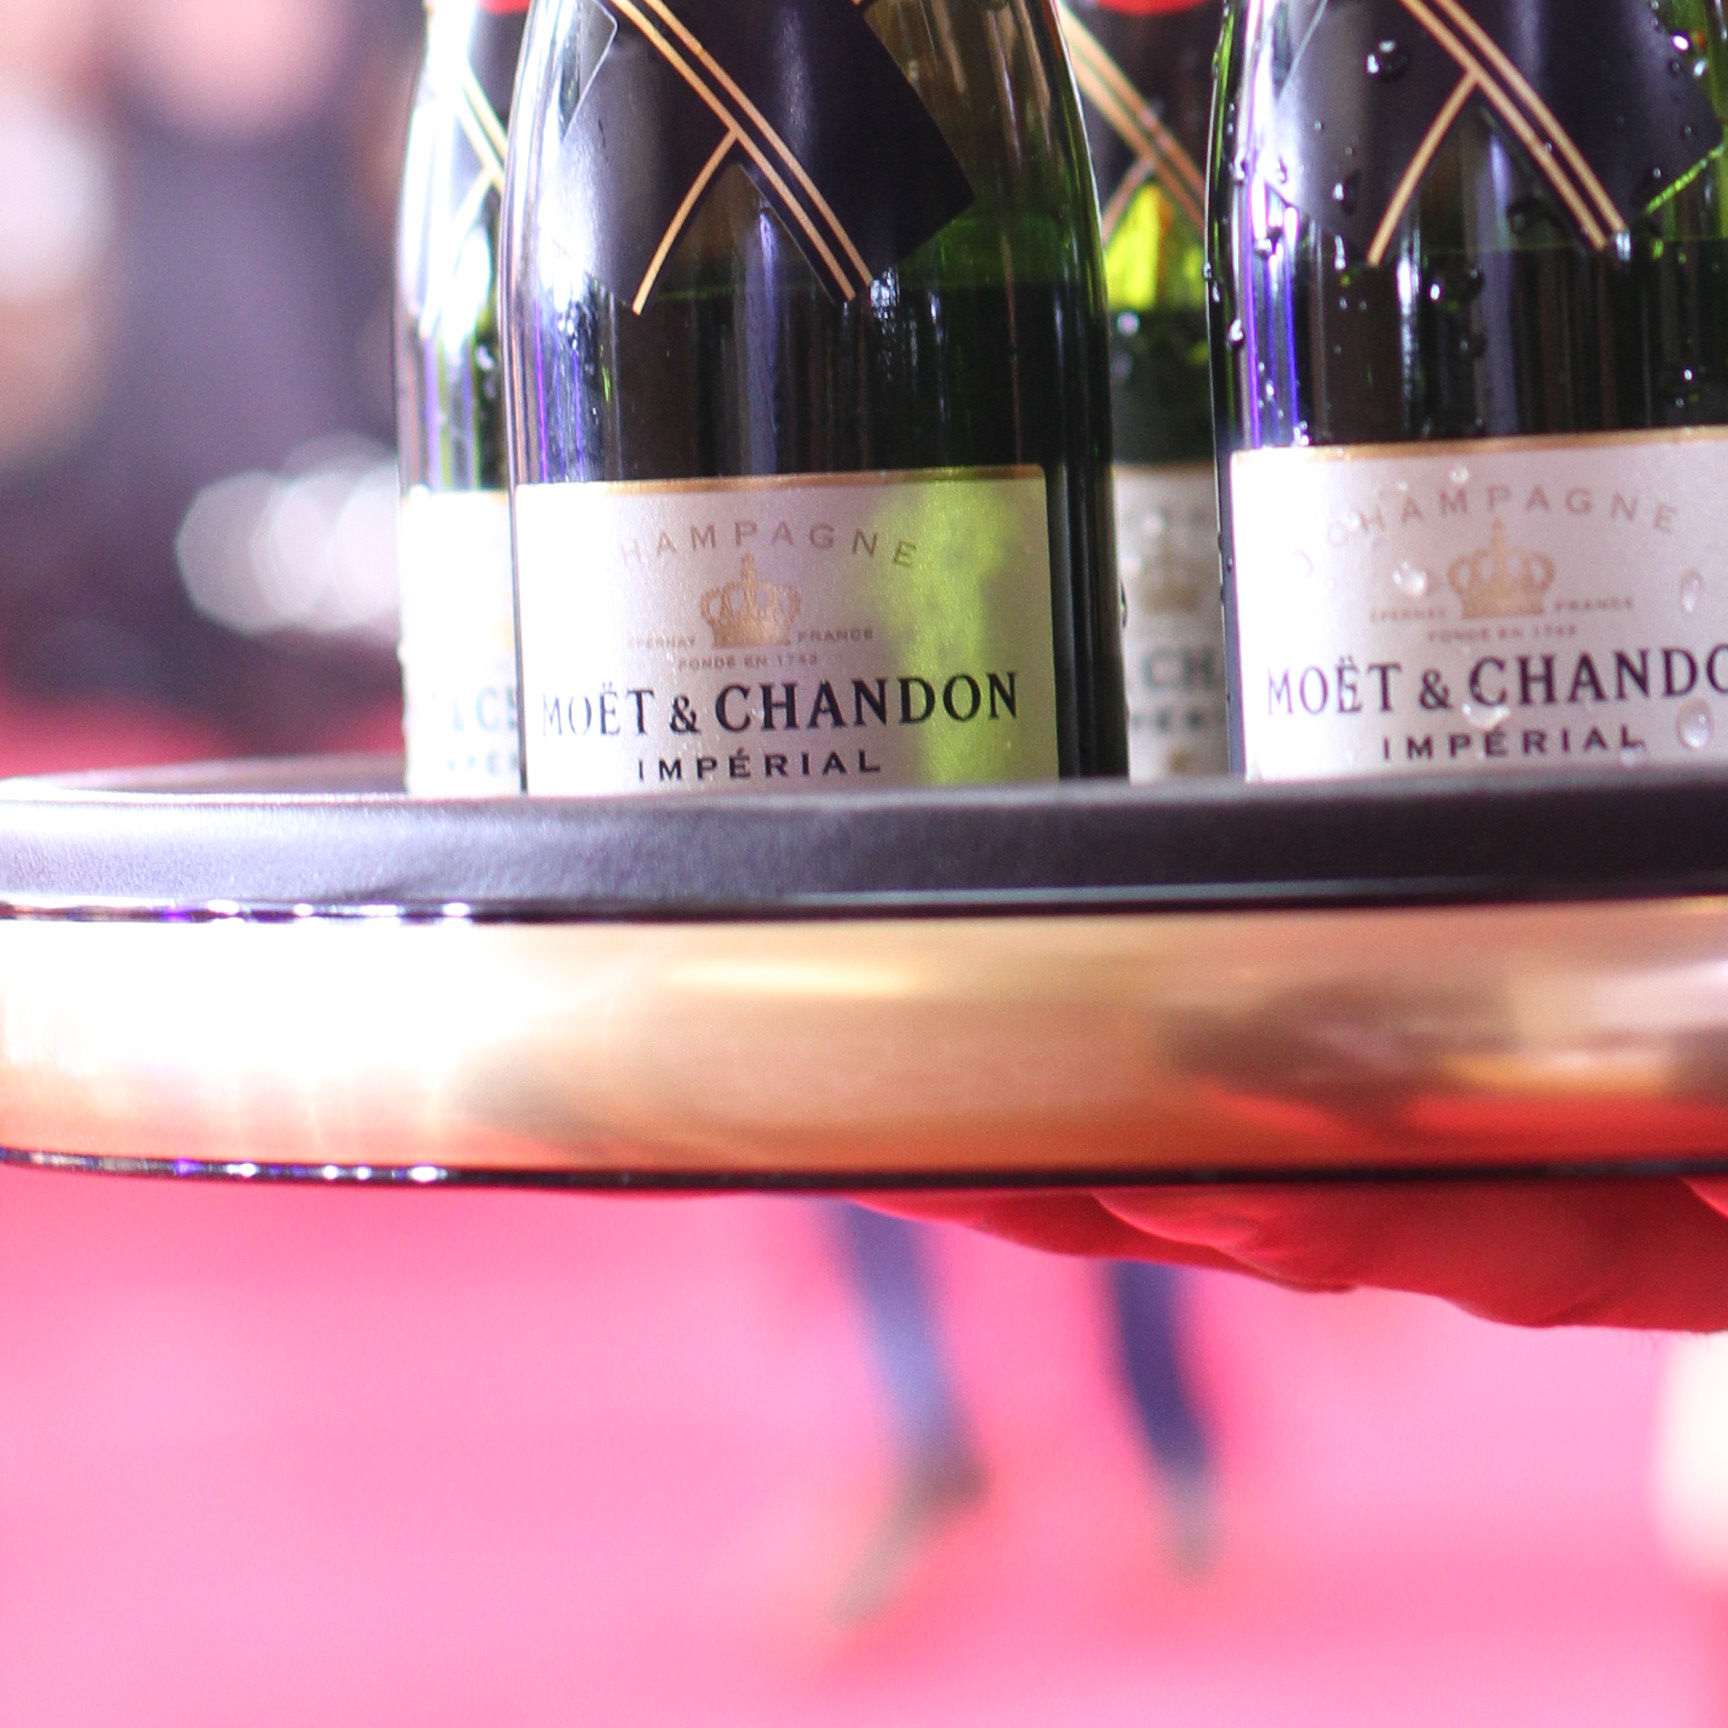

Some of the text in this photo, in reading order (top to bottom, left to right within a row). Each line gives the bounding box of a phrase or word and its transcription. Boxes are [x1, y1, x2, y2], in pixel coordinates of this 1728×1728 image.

[620, 520, 917, 568] HAMPAGNE
[542, 682, 655, 736] MOËT
[670, 694, 700, 735] &
[714, 671, 1019, 733] CHANDON
[1268, 656, 1403, 715] MOËT
[1419, 669, 1452, 711] &
[638, 748, 881, 782] IMPÉRIAL
